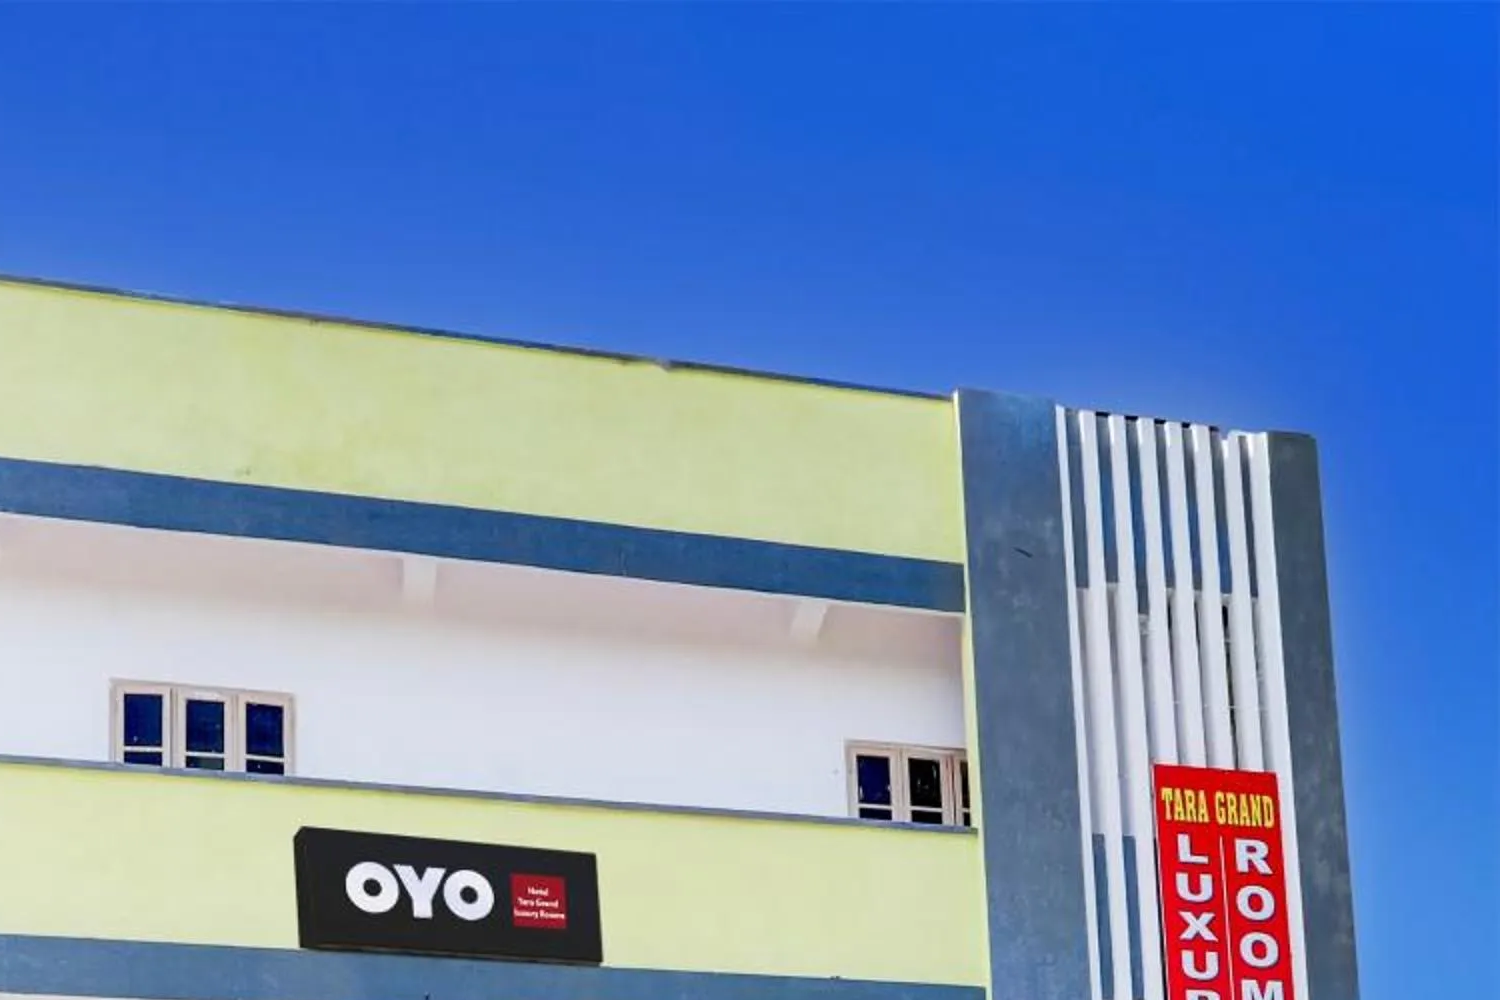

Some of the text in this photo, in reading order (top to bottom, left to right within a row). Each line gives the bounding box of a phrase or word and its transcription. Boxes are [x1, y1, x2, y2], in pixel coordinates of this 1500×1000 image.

[1161, 787, 1275, 829] TARA GRAND
[345, 861, 495, 921] OYO
